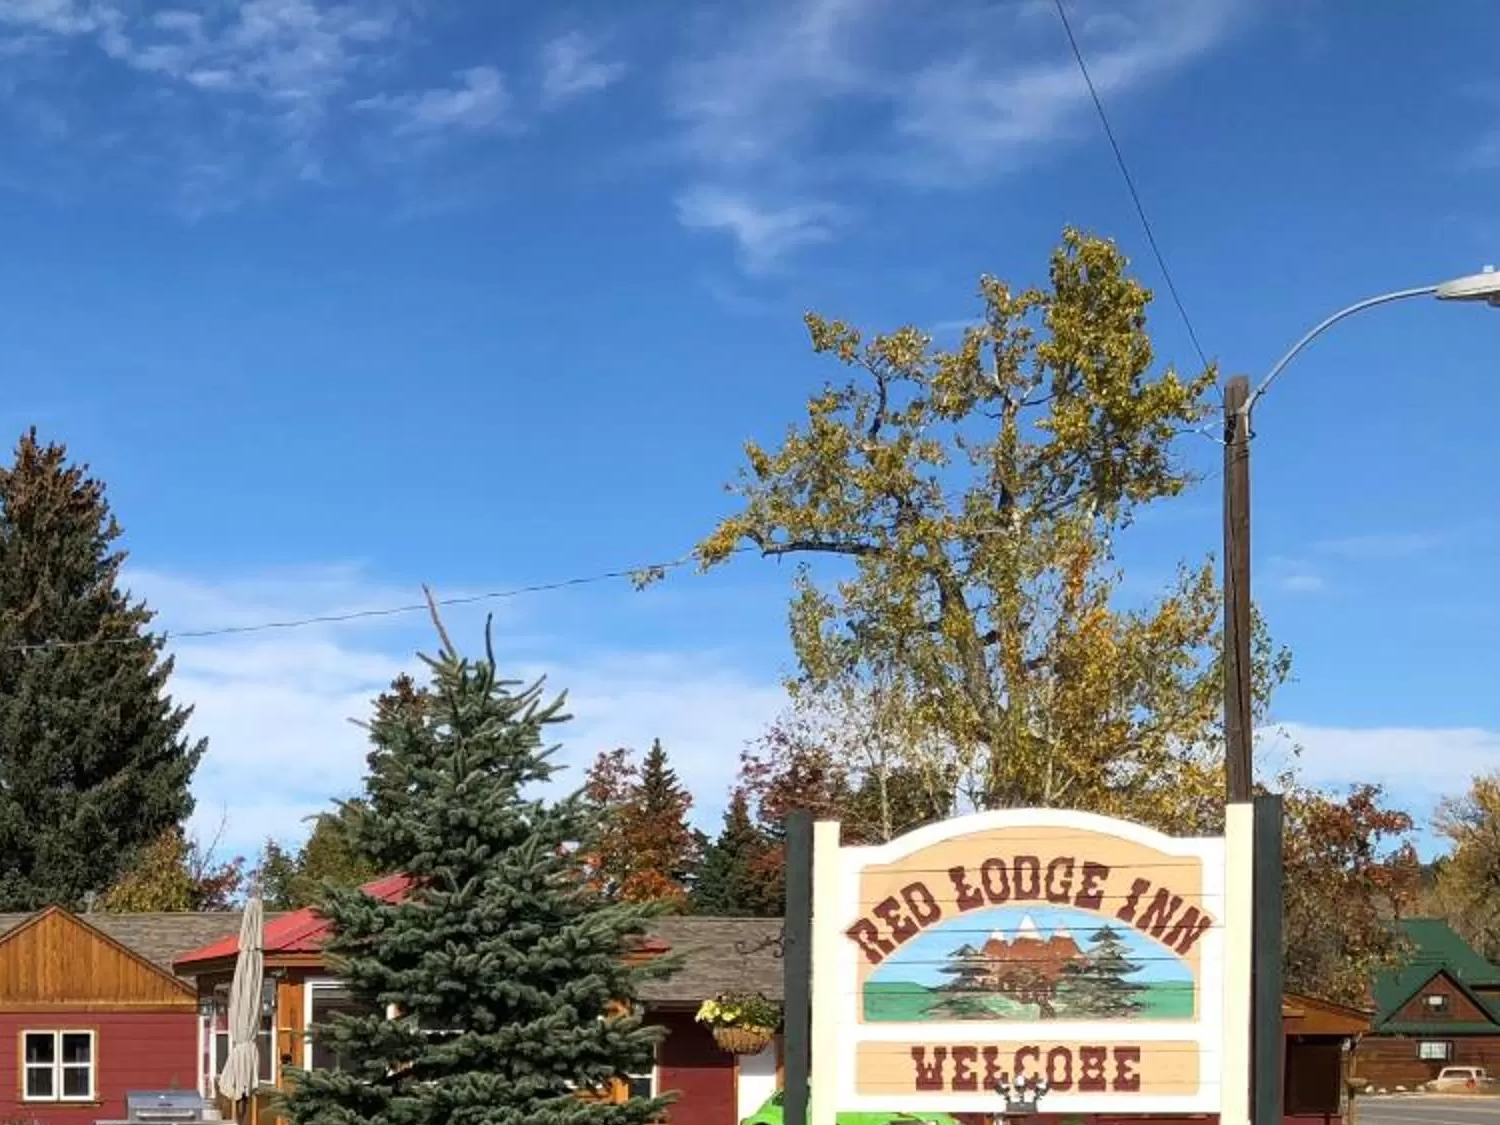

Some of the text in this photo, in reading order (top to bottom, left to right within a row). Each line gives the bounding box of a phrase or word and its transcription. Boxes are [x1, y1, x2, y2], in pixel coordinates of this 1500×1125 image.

[846, 855, 1213, 964] RED LODGE INN
[911, 1046, 1140, 1091] WELCOME
